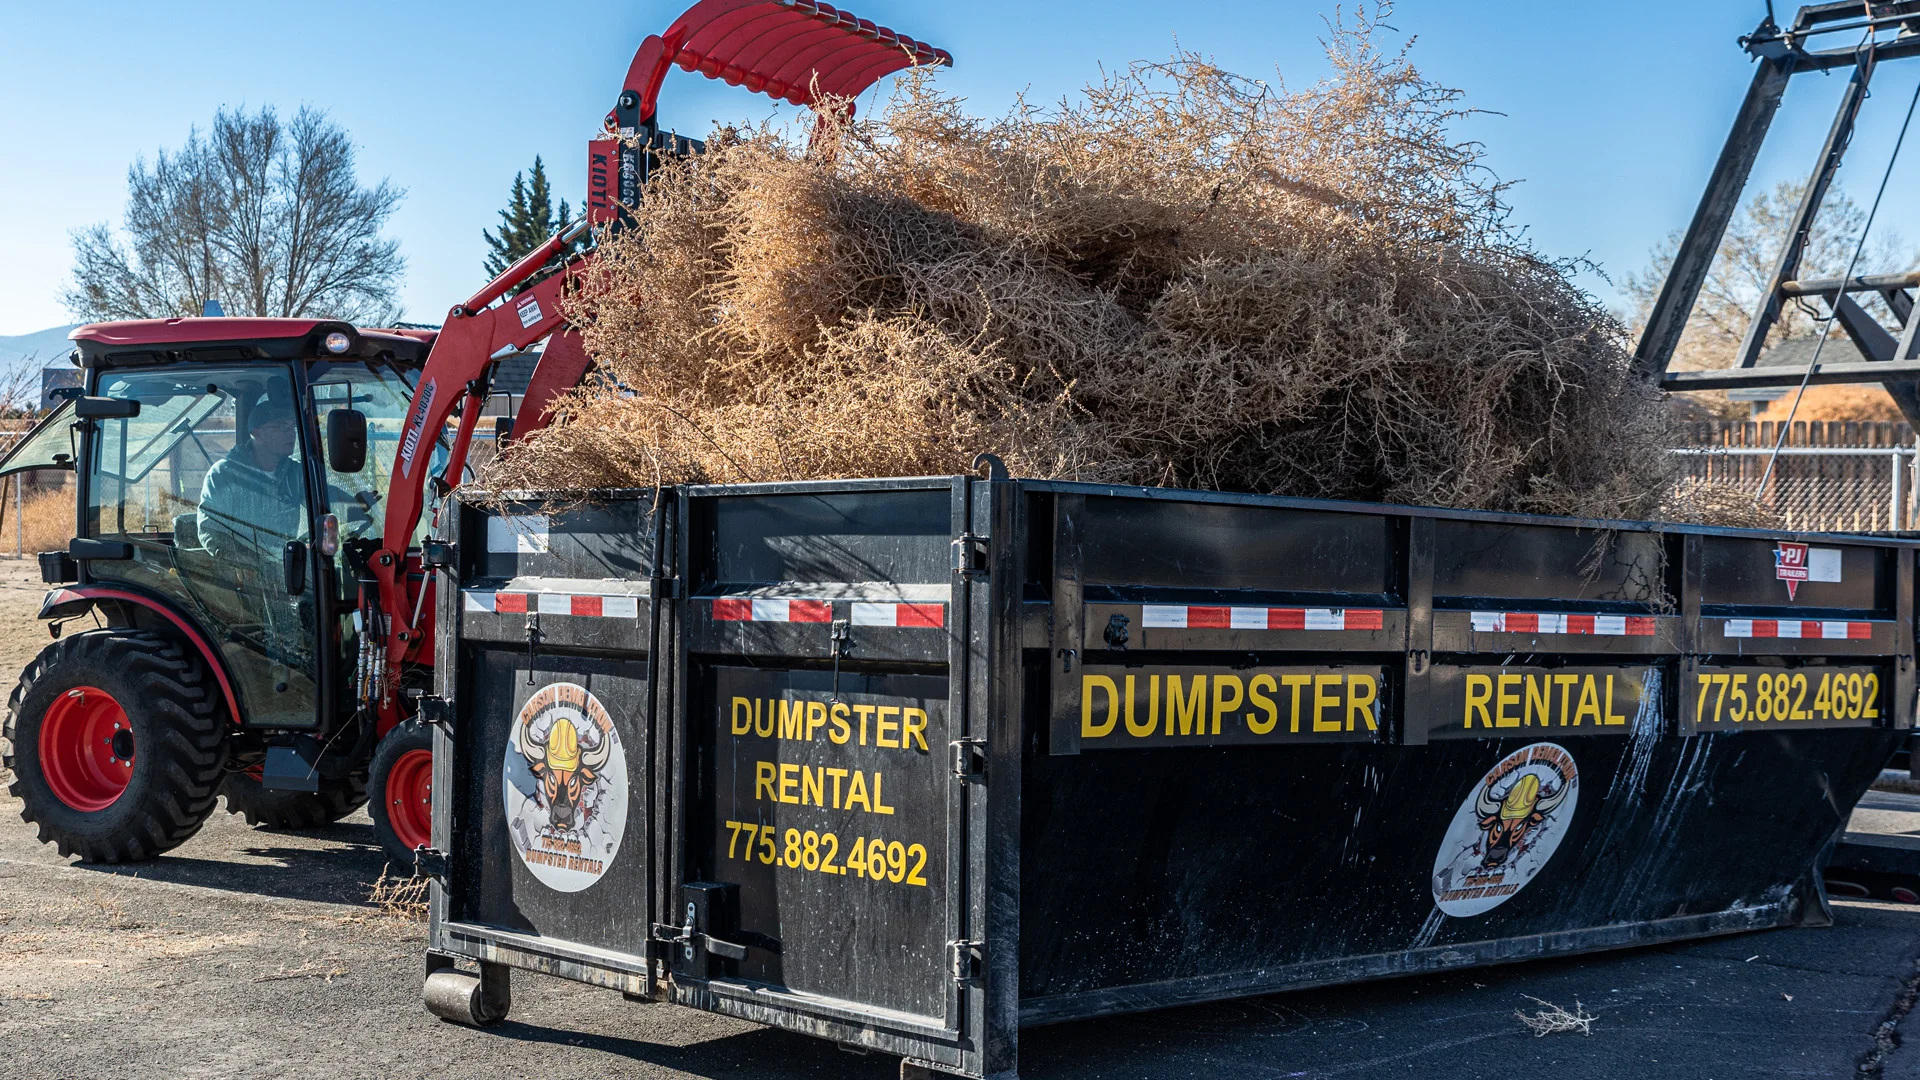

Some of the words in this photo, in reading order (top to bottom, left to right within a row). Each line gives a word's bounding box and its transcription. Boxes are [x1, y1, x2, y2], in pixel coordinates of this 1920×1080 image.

[591, 153, 608, 208] KIOTI
[400, 427, 419, 462] KIOTI
[1779, 568, 1807, 578] TRAILERS
[1785, 548, 1802, 564] PJ
[521, 686, 556, 727] CARSON
[557, 686, 614, 734] DEMOLITION
[731, 696, 929, 751] DUMPSTER
[1081, 673, 1378, 738] DUMPSTER
[1463, 674, 1626, 729] RENTAL
[1697, 673, 1879, 722] 775.882.4692
[755, 760, 895, 815] RENTAL
[1485, 748, 1531, 786] CARSON
[1531, 745, 1577, 781] DEMOLITION
[525, 848, 568, 869] DUMPSTER
[568, 855, 604, 875] RENTALS
[725, 820, 927, 887] 775.882.4692
[1438, 887, 1485, 902] DUMPSTER
